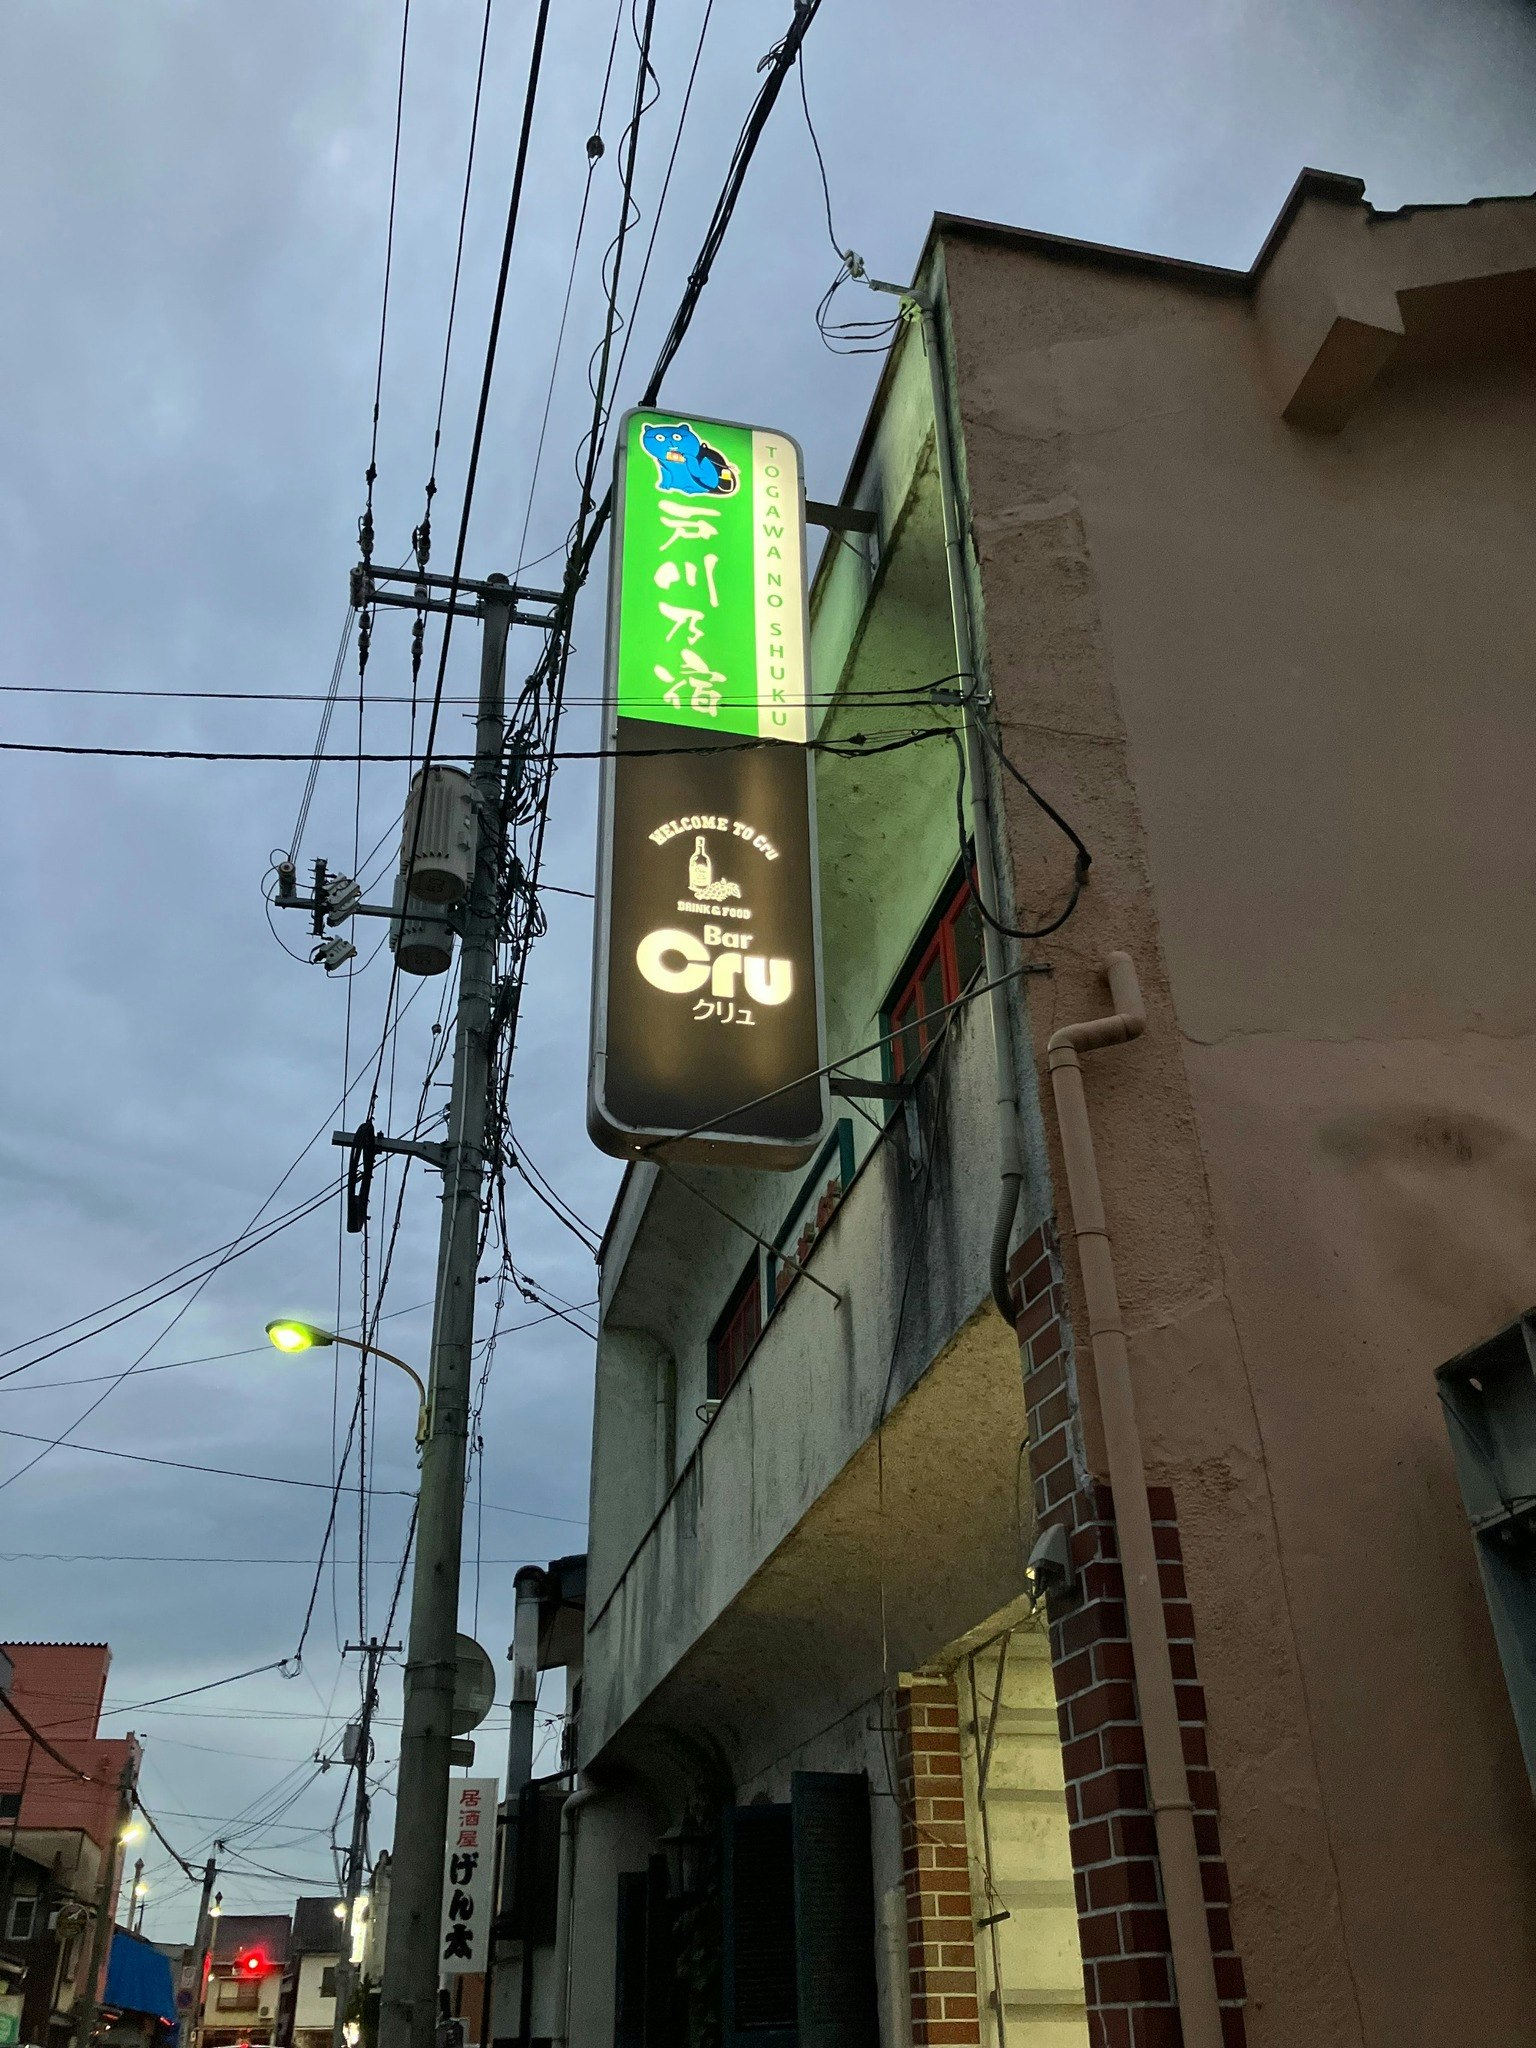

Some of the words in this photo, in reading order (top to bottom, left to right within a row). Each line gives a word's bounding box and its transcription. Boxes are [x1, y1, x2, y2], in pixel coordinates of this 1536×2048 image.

[763, 446, 784, 559] TOGAWA
[654, 499, 727, 717] 戸川乃宿
[767, 573, 783, 608] NO
[769, 622, 787, 726] SHUKU
[648, 815, 729, 846] WELCOME
[732, 821, 755, 841] TO
[677, 901, 711, 914] DRINK
[722, 907, 752, 920] FOOD
[703, 924, 754, 950] Bar
[636, 928, 793, 1006] Cru
[692, 998, 756, 1026] クリュ
[456, 1789, 481, 1848] 居酒屋
[444, 1851, 479, 1960] げん太
